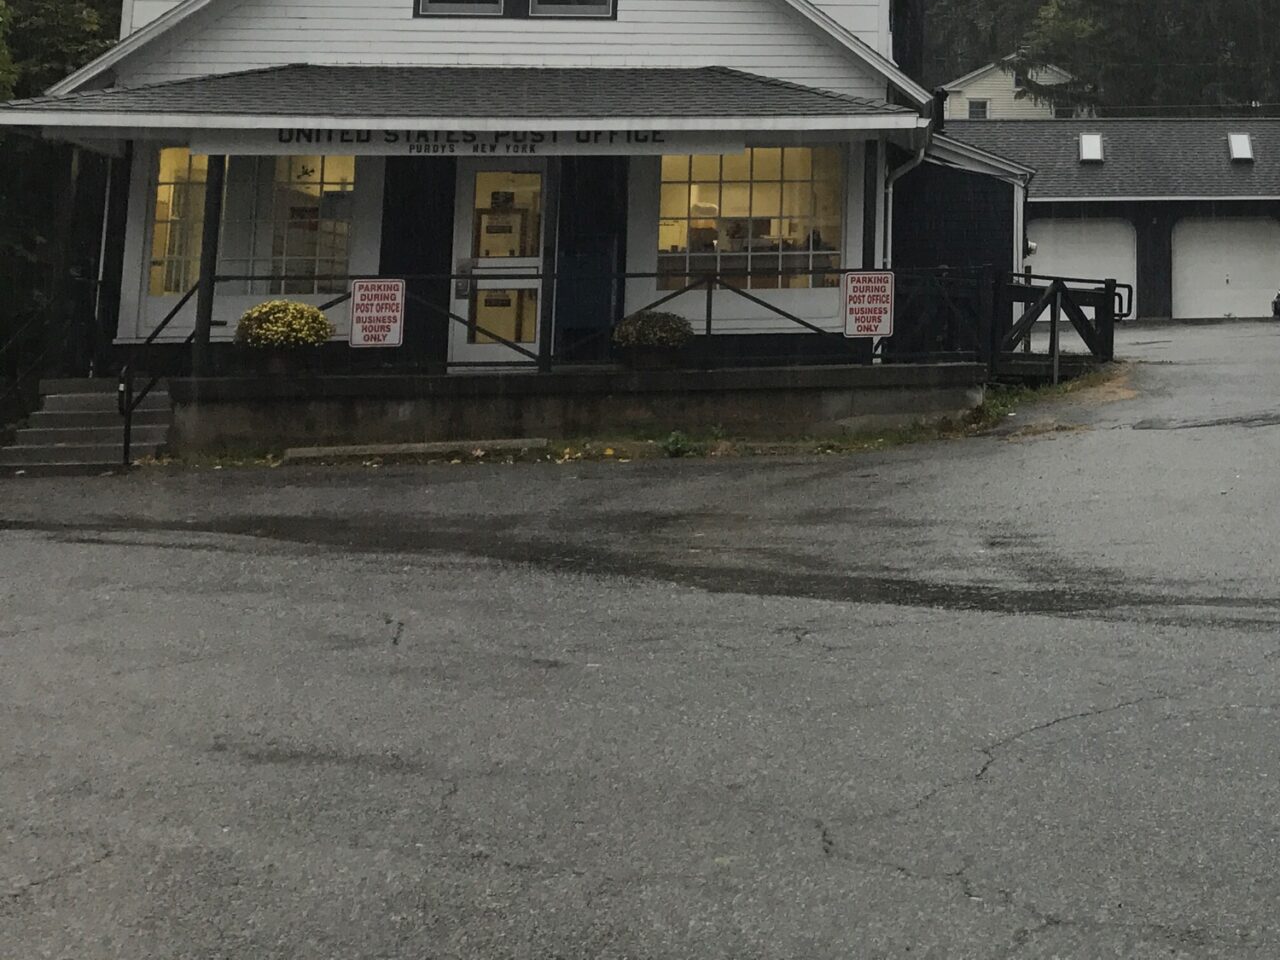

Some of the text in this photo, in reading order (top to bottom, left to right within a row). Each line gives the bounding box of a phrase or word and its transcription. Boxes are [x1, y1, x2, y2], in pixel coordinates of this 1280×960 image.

[278, 128, 665, 144] UNITED STATES POST OFFICE
[472, 143, 497, 154] NEW
[505, 143, 536, 154] YORK
[850, 276, 889, 284] PARKING
[358, 283, 400, 292] PARKING
[852, 285, 887, 293] DURING
[360, 293, 397, 302] DURING
[848, 294, 890, 305] POST OFFICE
[355, 302, 400, 313] POST OFFICE
[849, 306, 888, 315] BUSINESS
[355, 315, 398, 324] BUSINESS
[854, 315, 882, 324] HOURS
[361, 324, 391, 333] HOURS
[856, 324, 879, 333] ONLY
[363, 333, 388, 342] ONLY
